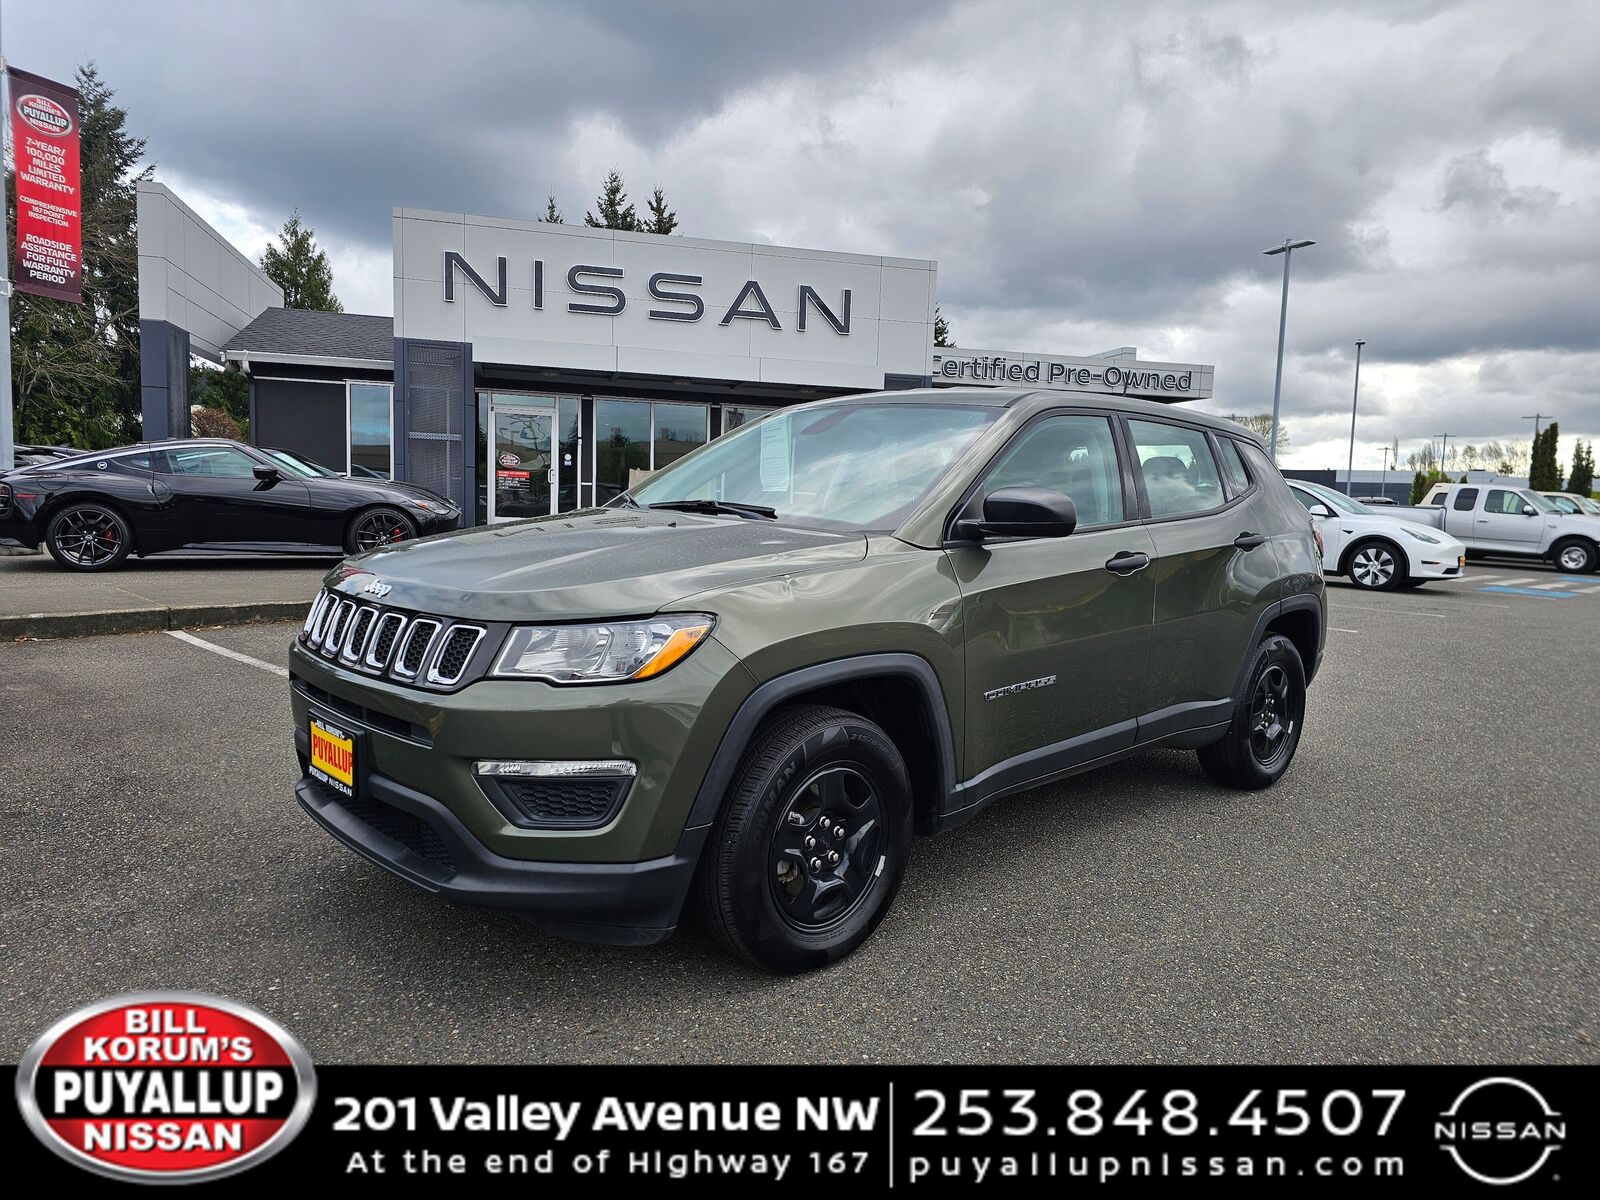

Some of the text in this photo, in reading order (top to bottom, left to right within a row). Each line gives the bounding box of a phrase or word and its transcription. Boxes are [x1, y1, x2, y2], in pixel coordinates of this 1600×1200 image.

[23, 105, 67, 128] PUYALLUP
[30, 118, 60, 132] NISSAN
[25, 136, 66, 157] 7-YEAR/
[25, 145, 65, 165] 100,000
[28, 165, 66, 184] LIMITED
[33, 157, 62, 174] MILES
[20, 171, 75, 195] WARRANTY
[19, 195, 78, 218] COMPREHENSIVE
[43, 209, 65, 220] POINT
[28, 211, 69, 228] INSPECTION
[20, 241, 77, 262] ASSISTANCE
[26, 233, 73, 253] ROADSIDE
[22, 259, 76, 278] WARRANTY
[26, 251, 70, 269] FOR FULL
[30, 270, 66, 285] PERIOD
[443, 250, 852, 336] NISSAN
[1047, 362, 1192, 392] Pre-Owned
[363, 578, 393, 598] Jeep
[313, 733, 352, 775] PUYALLUP
